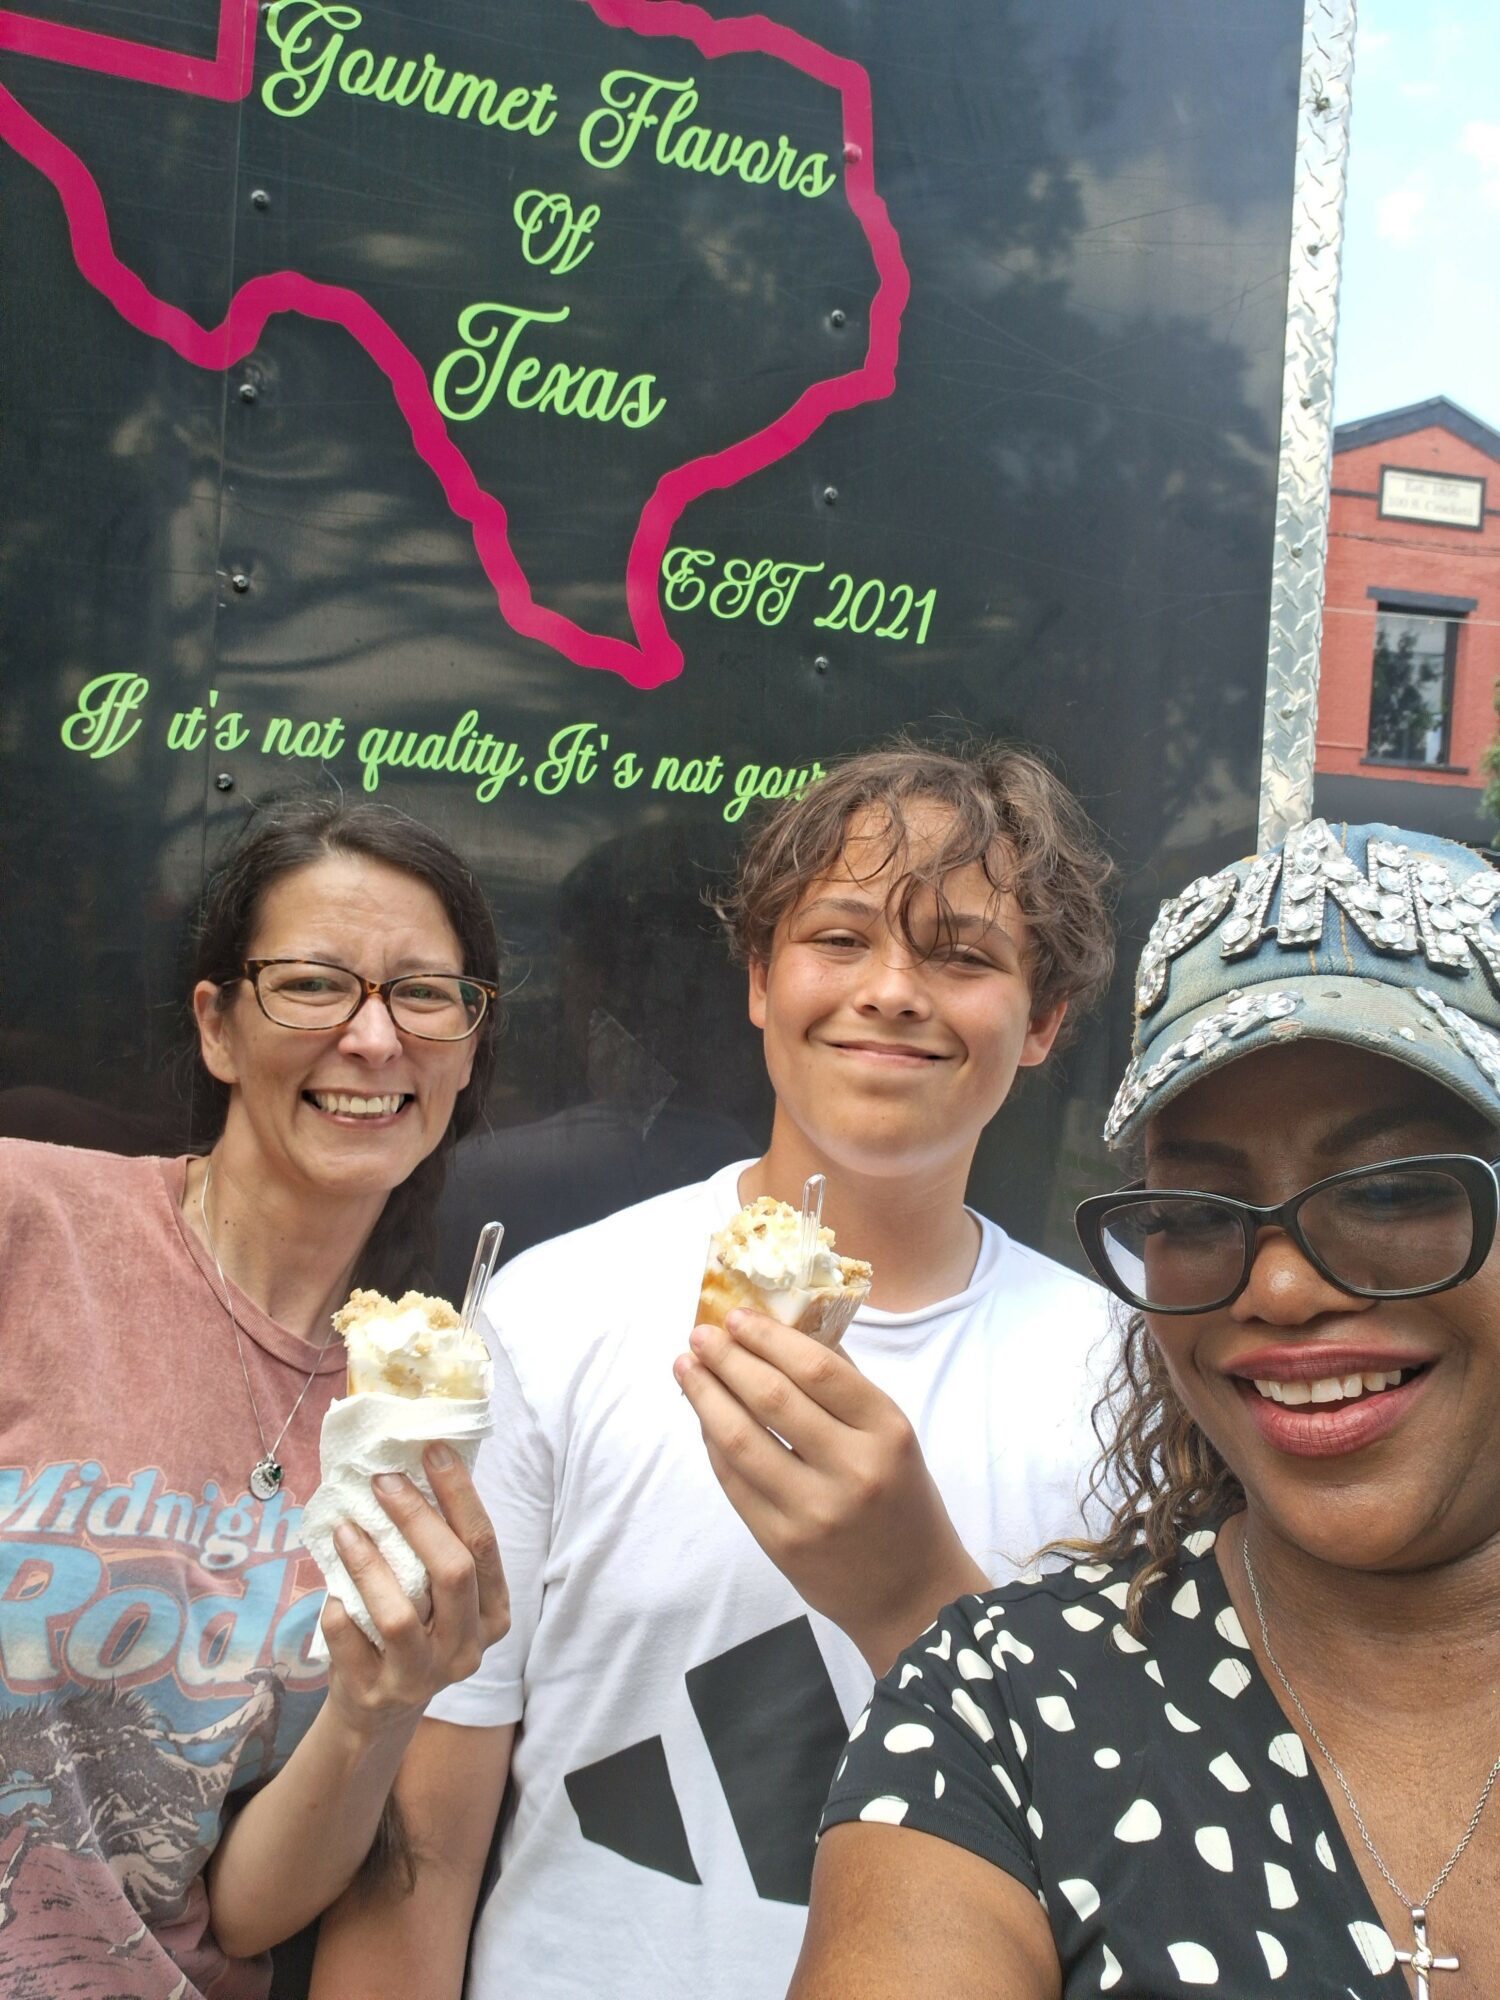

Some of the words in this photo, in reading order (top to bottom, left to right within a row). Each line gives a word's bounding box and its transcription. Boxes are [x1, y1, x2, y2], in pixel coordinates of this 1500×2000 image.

[262, 0, 557, 136] Gourmet
[580, 69, 836, 199] Flavors
[514, 190, 601, 275] Of
[432, 302, 667, 429] Texas
[661, 546, 825, 627] EST
[813, 573, 938, 645] 2021
[60, 672, 150, 760] If
[166, 691, 249, 752] it's
[261, 718, 345, 758] not
[651, 755, 725, 794] not
[1135, 816, 1500, 1018] PINK
[0, 1459, 306, 1570] Midnigh
